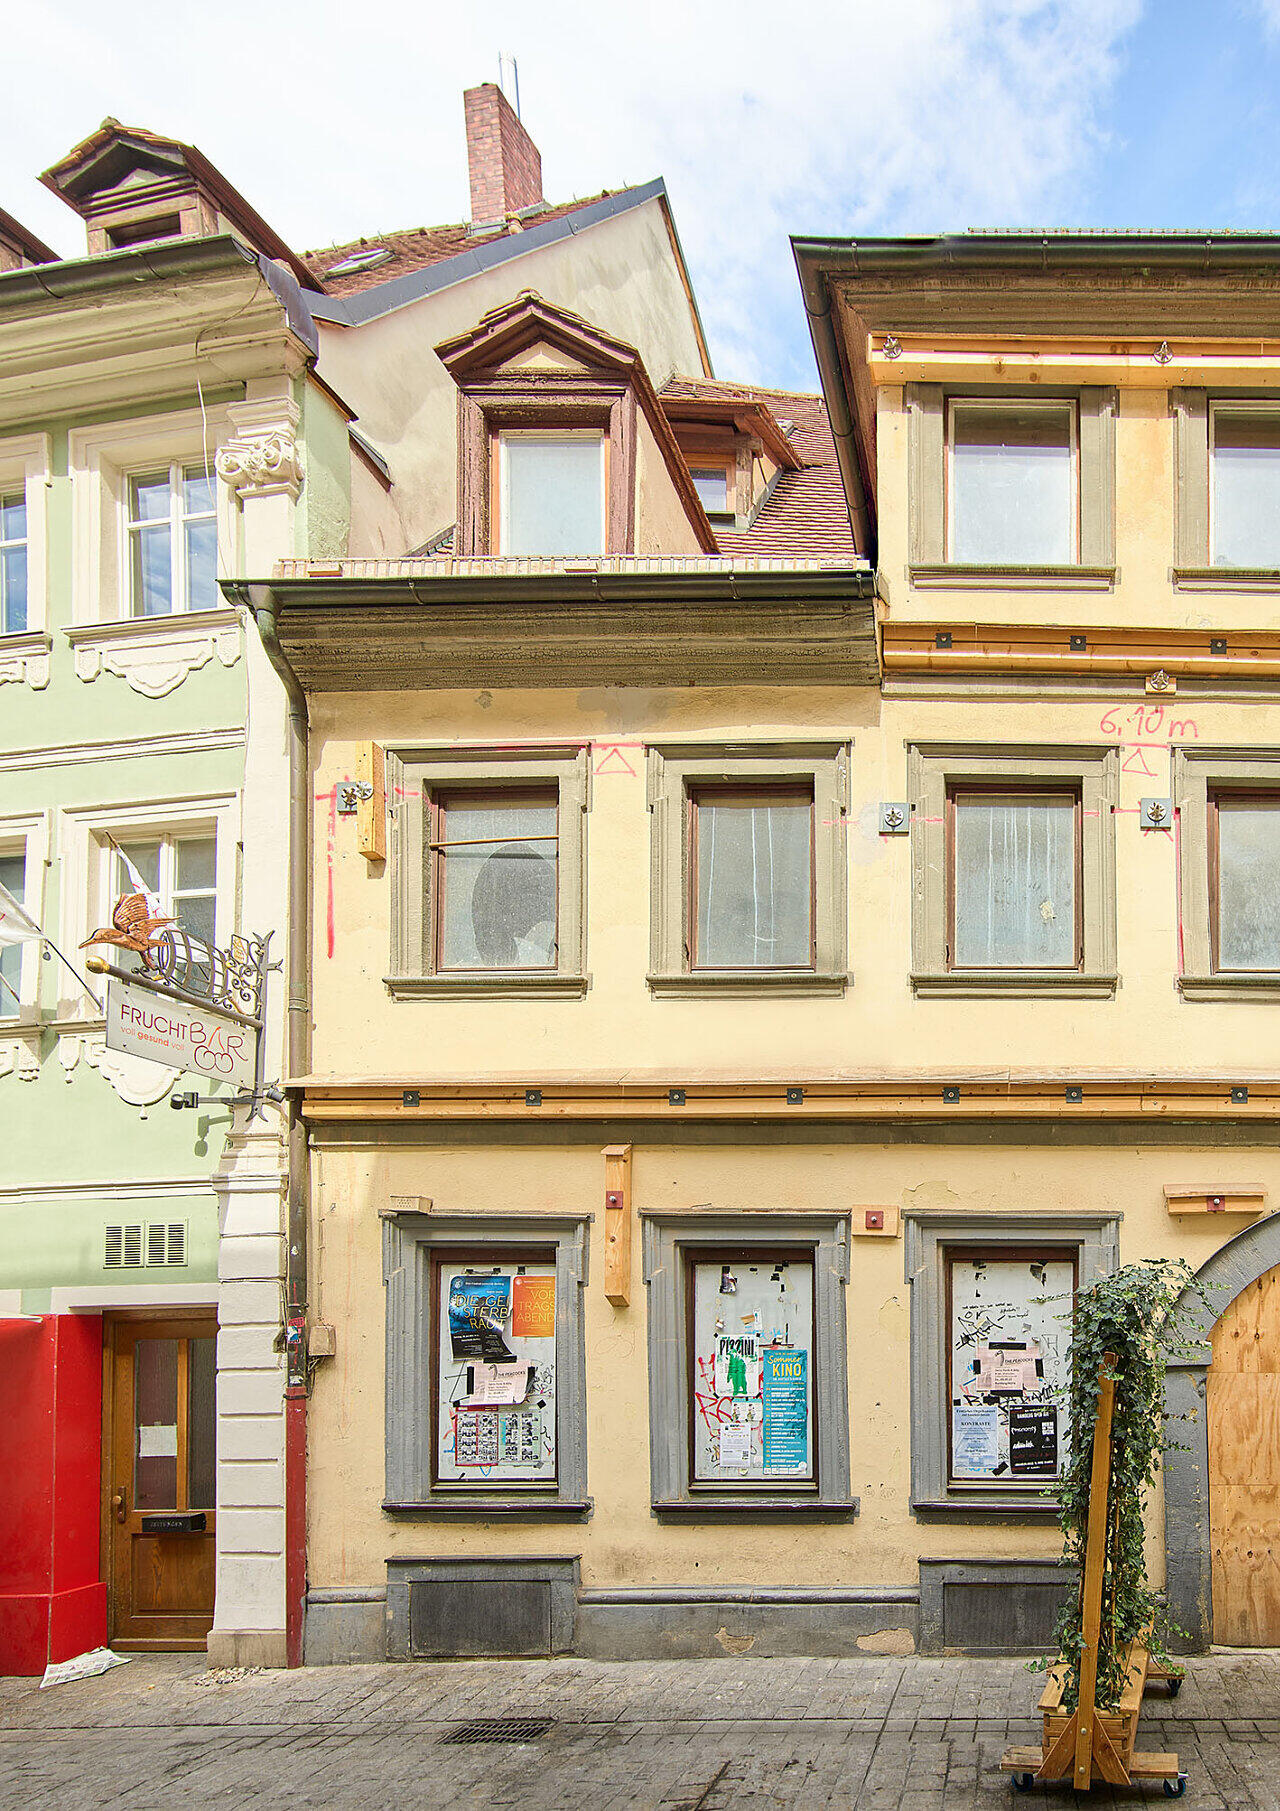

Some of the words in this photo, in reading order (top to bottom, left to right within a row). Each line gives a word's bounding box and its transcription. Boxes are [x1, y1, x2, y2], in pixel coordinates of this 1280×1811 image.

[1168, 719, 1199, 737] m
[120, 1026, 136, 1036] voll
[137, 1031, 169, 1047] gesund
[171, 1042, 185, 1051] voll
[531, 1289, 556, 1300] VOR
[456, 1295, 478, 1307] DIE
[518, 1301, 556, 1311] TRAGS
[463, 1306, 509, 1319] STERB
[516, 1312, 555, 1323] ABEND
[767, 1355, 801, 1365] Sommer
[772, 1363, 802, 1378] KINO
